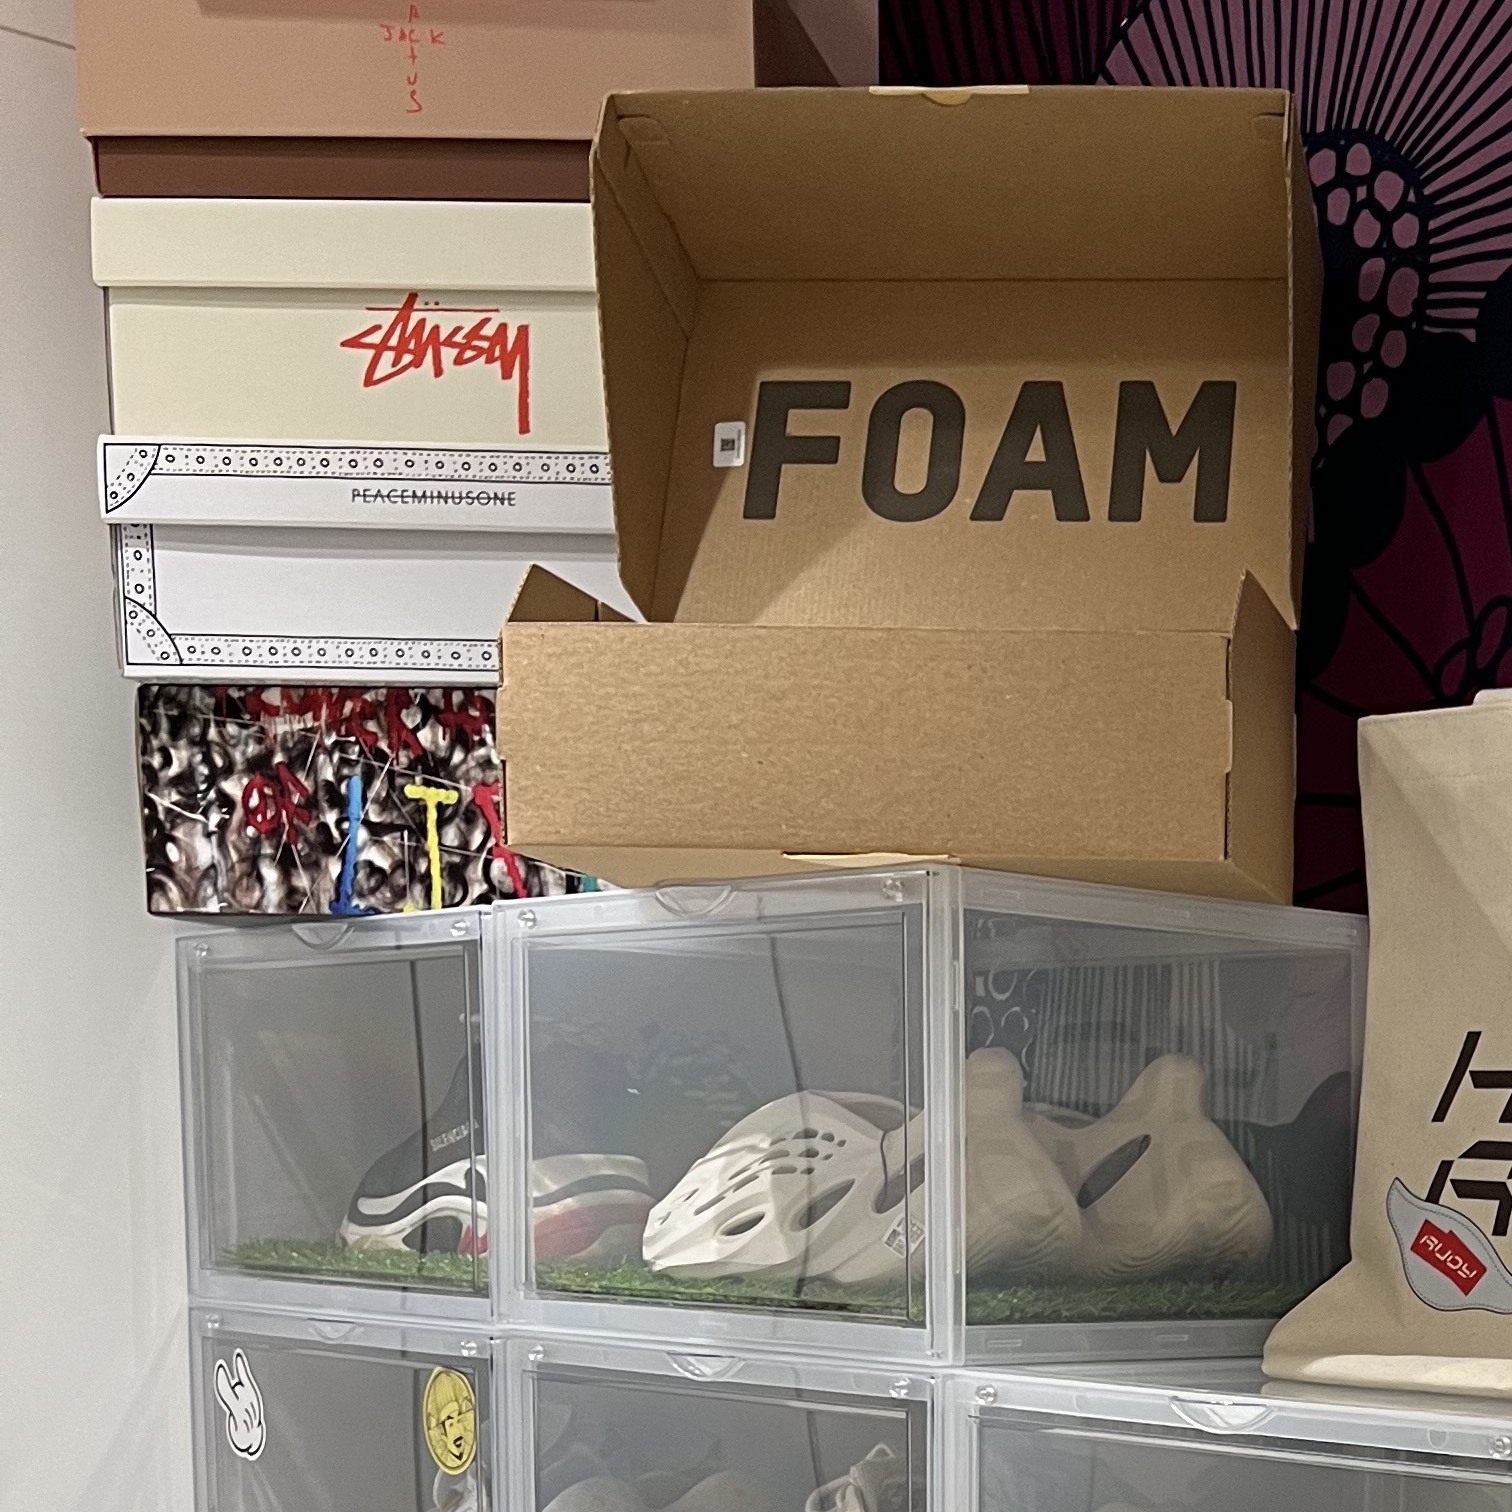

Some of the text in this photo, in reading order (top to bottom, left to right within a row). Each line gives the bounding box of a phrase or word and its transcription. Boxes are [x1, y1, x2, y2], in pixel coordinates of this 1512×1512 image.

[743, 380, 1237, 523] FOAM
[351, 487, 517, 508] PEACEMINUSONE
[1420, 1235, 1477, 1278] RUDY
